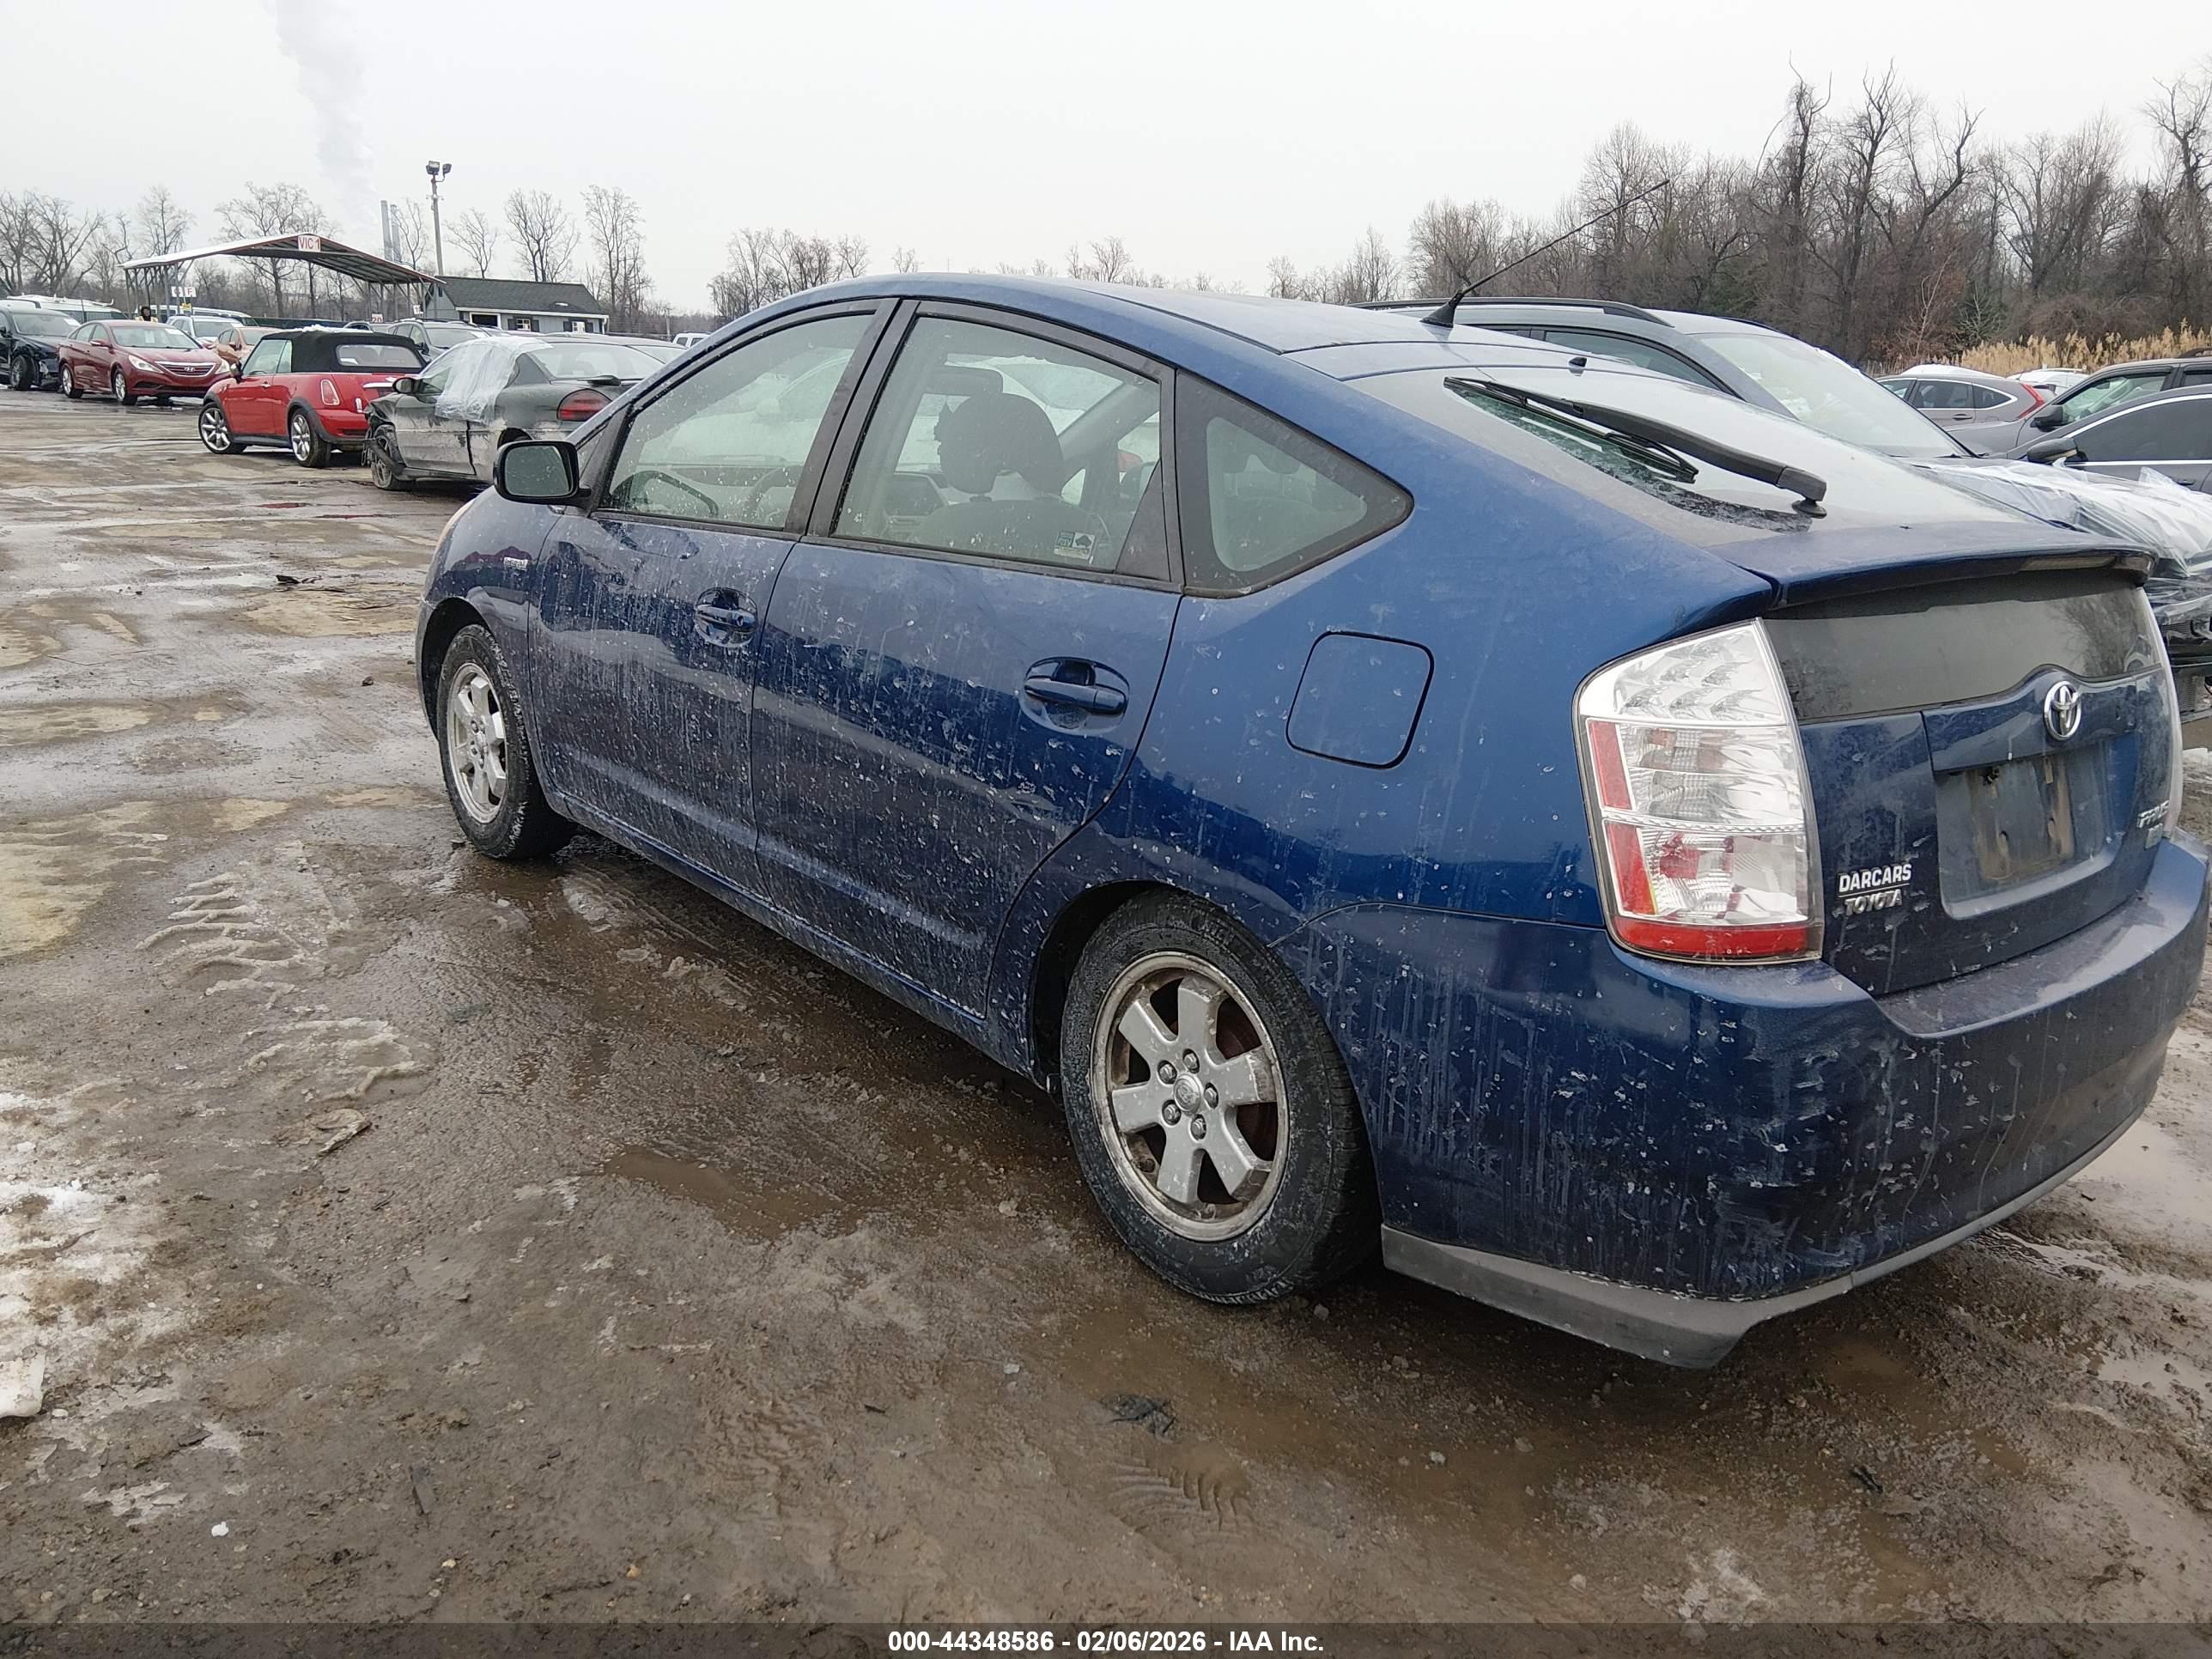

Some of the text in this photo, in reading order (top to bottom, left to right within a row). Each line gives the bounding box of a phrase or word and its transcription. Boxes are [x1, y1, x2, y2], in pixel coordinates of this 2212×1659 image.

[299, 236, 320, 250] VIC 1
[1838, 862, 1912, 893] DARCARS
[1844, 888, 1903, 916] TOYOTA
